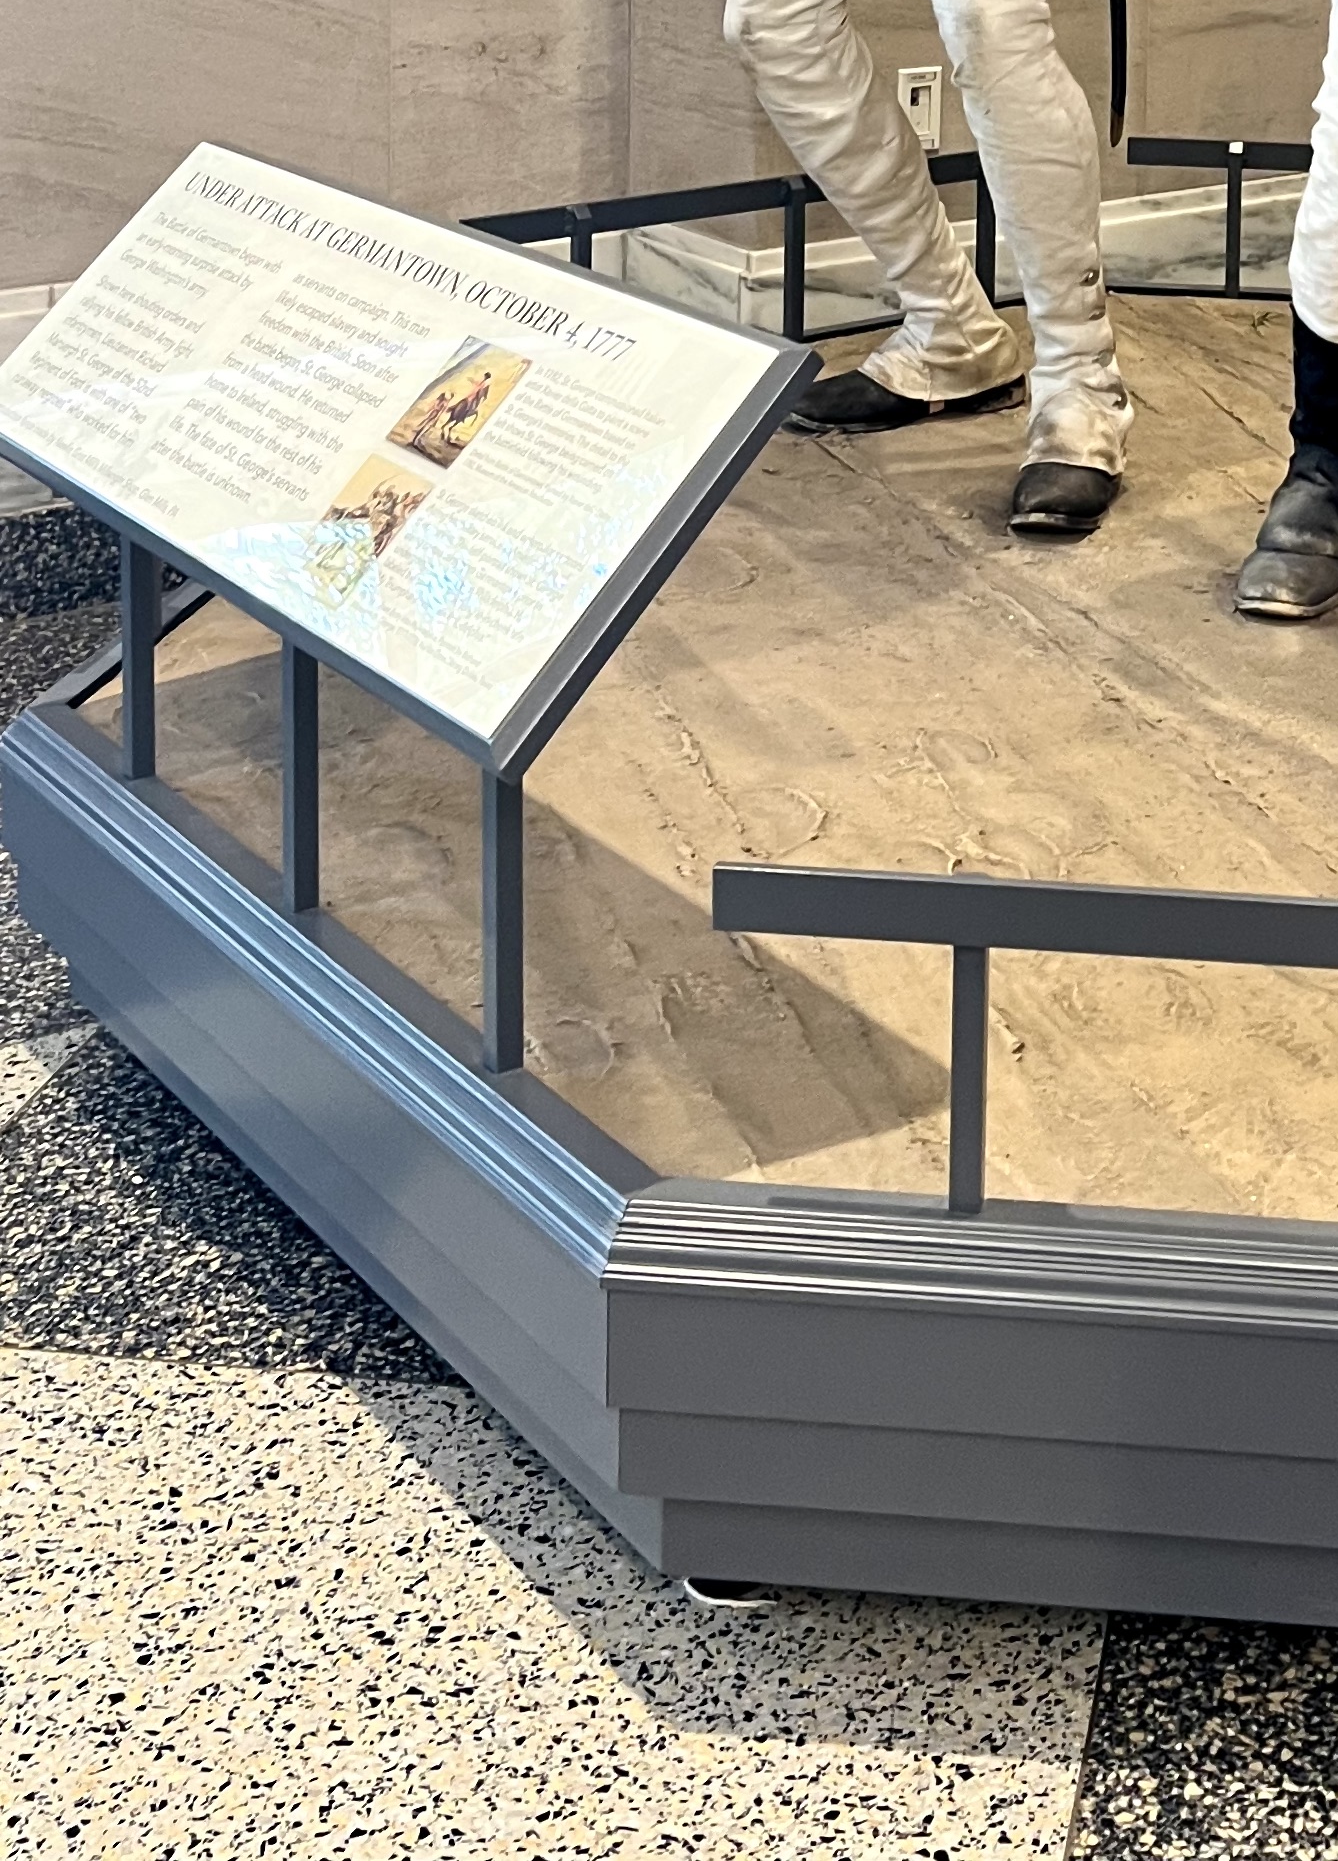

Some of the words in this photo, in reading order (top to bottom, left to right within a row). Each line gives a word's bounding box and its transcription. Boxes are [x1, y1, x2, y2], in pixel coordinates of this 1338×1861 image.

[184, 171, 245, 208] UNDER
[235, 194, 304, 233] ATTACK
[298, 218, 335, 242] AT
[326, 227, 464, 300] GERMANTOWN,
[464, 281, 569, 337] OCTOBER
[565, 321, 585, 347] 4,
[582, 326, 637, 361] 1777
